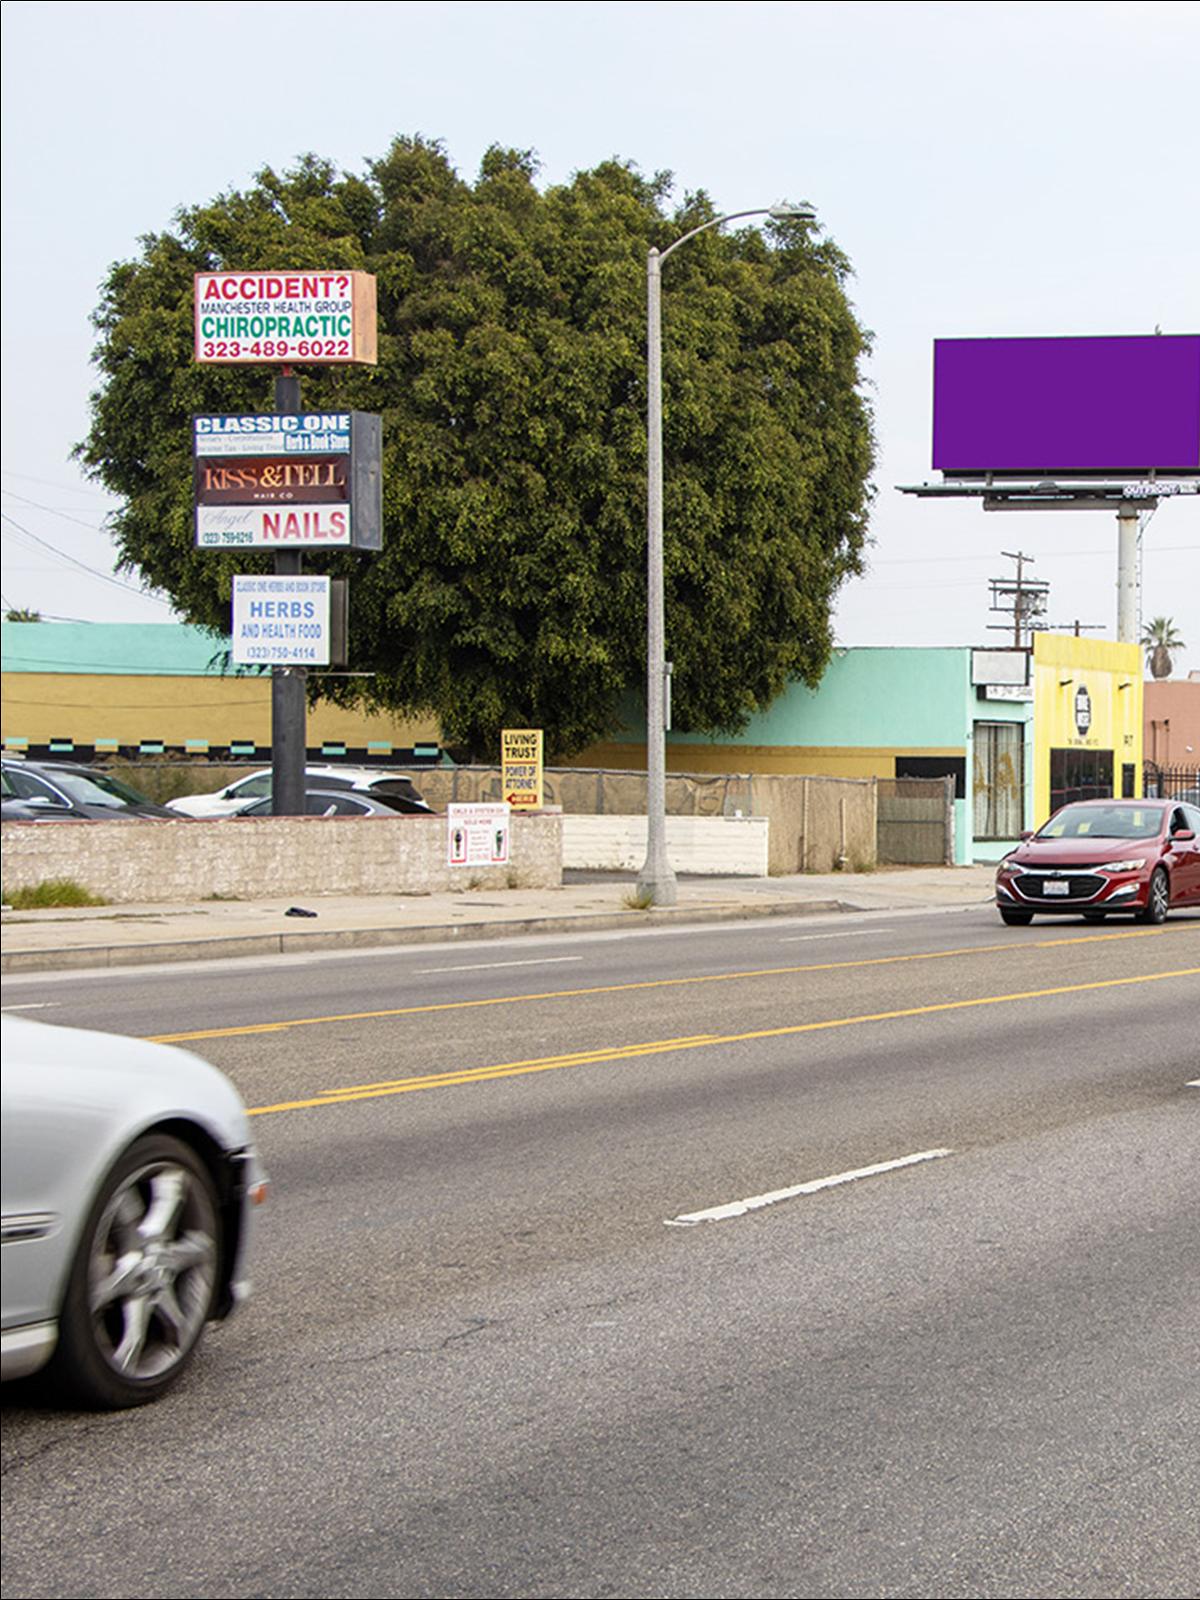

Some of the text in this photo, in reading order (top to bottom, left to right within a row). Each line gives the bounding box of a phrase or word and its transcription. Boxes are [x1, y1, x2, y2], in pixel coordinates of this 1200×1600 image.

[204, 276, 349, 300] ACCIDENT?
[201, 300, 352, 314] MANCHESTER HEALTH GROUP
[201, 315, 351, 338] CHIROPRACTIC
[203, 340, 349, 357] 323-489-6022
[196, 414, 350, 433] CLASSIC ONE
[204, 467, 258, 490] KISS
[262, 511, 346, 540] NAILS
[250, 601, 315, 619] HERBS
[241, 623, 322, 639] AND HEALTH FOOD
[504, 733, 537, 745] LIVING
[505, 747, 537, 758] TRUST
[505, 766, 527, 777] POWER
[505, 778, 537, 789] ATTORNEY
